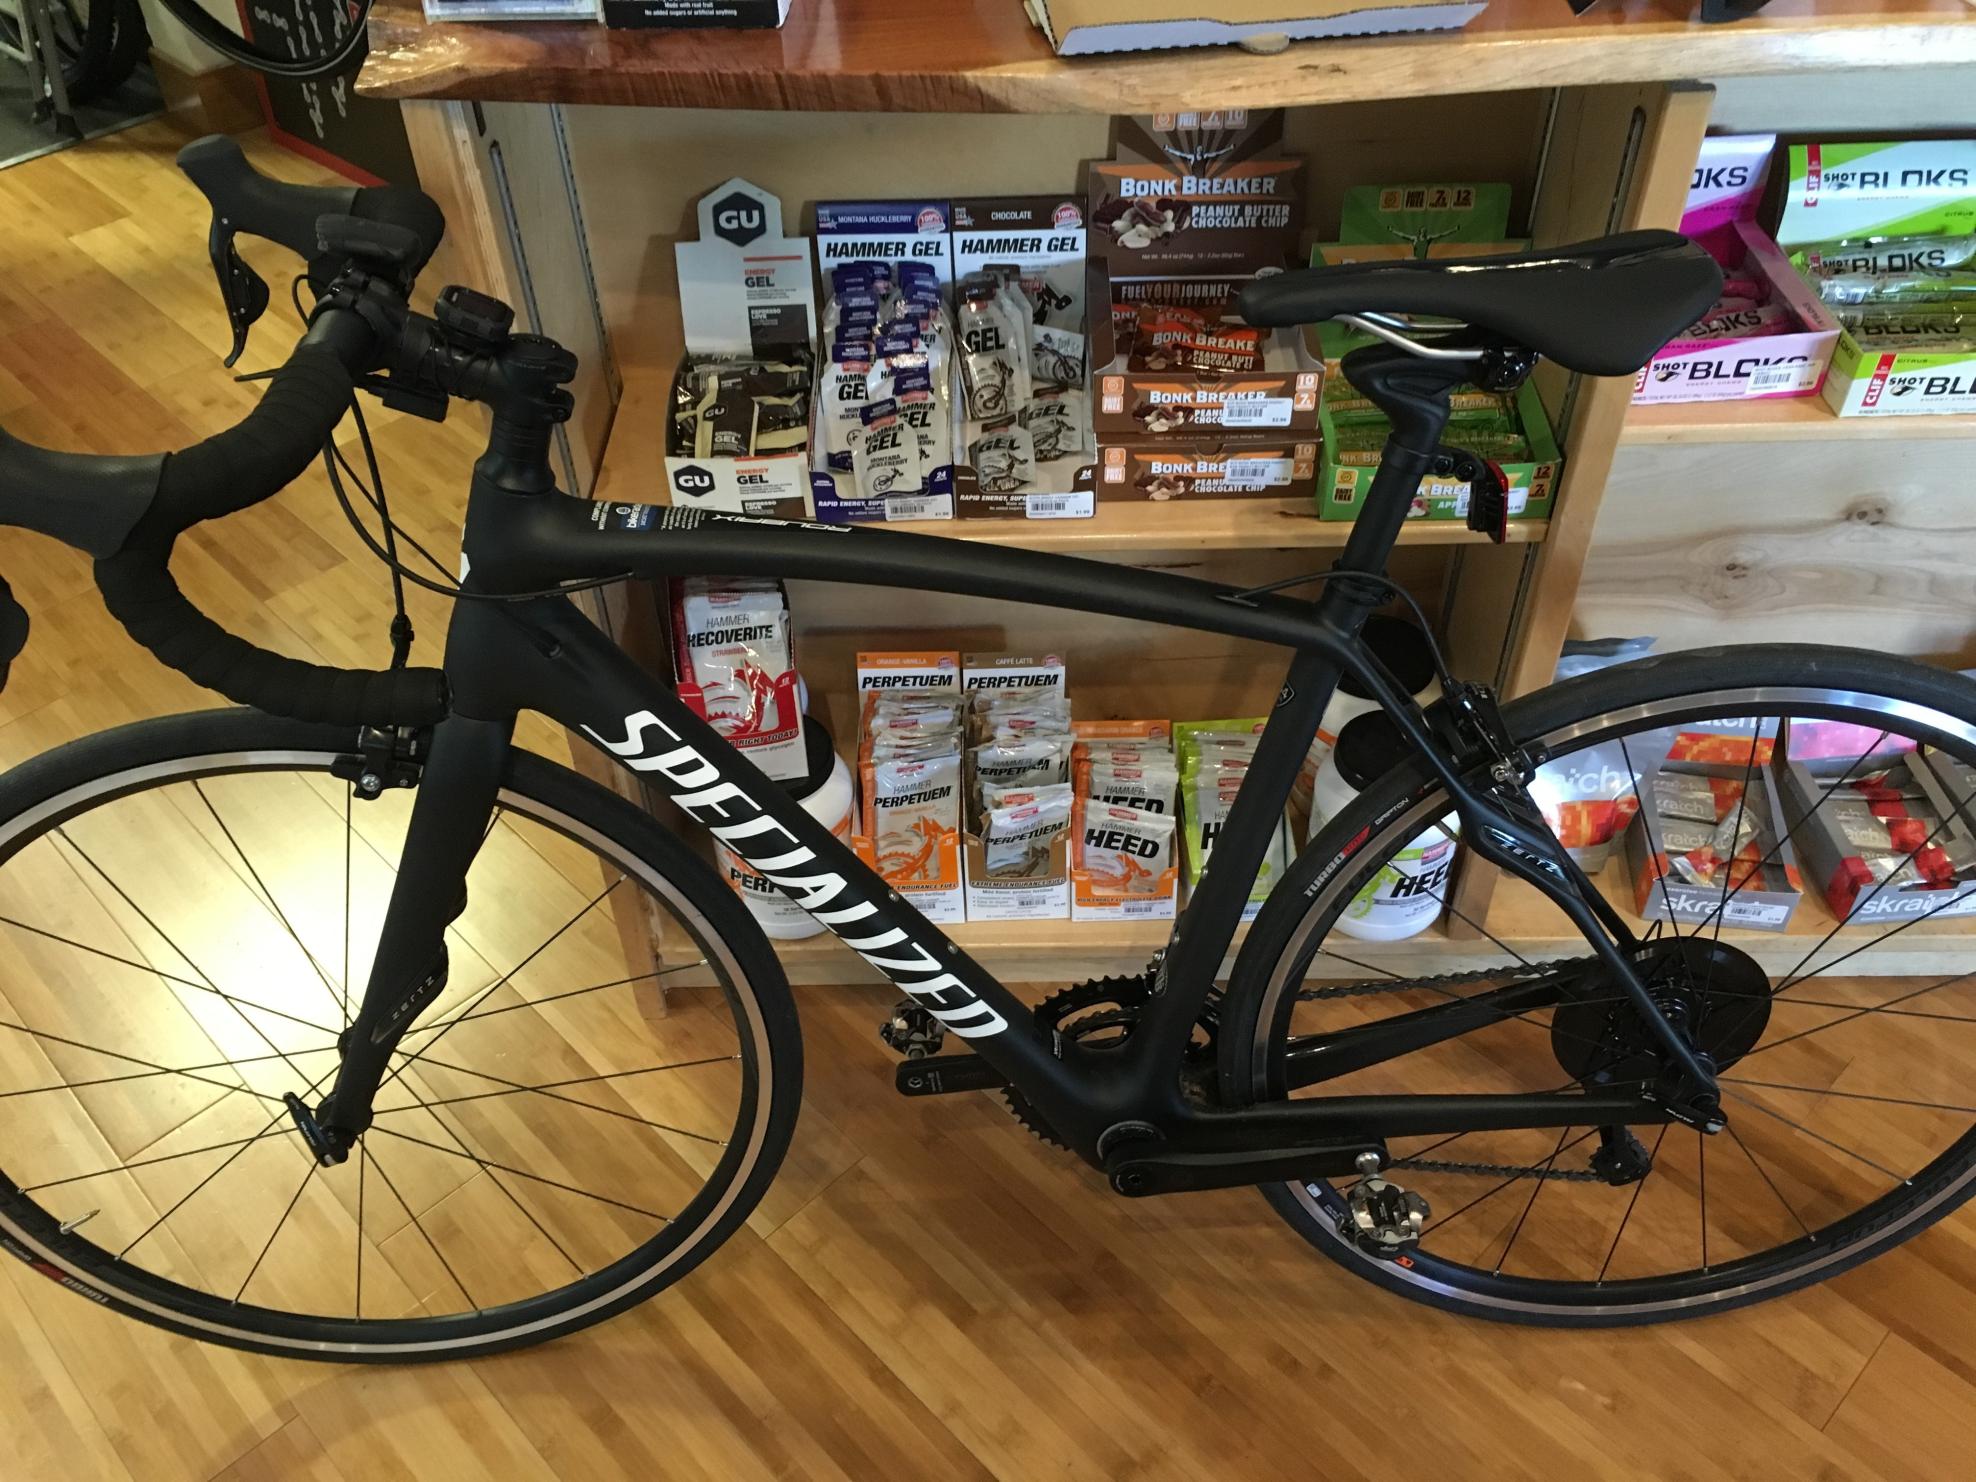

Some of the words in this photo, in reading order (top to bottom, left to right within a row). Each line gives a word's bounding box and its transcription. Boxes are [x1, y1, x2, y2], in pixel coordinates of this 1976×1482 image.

[1823, 172, 1857, 182] SHOT
[1120, 177, 1178, 197] BONK
[1182, 176, 1276, 195] BREAKER
[991, 211, 1032, 221] CHOCOLATE
[1191, 205, 1239, 217] PEANUT
[1244, 205, 1290, 217] BUTTER
[718, 209, 760, 230] GU
[837, 215, 869, 224] MONTANA
[868, 215, 912, 224] HUCKLEBERRY
[1191, 216, 1257, 228] CHOCOLATE
[1261, 216, 1289, 227] CHIP
[825, 242, 907, 258] HAMMER
[911, 241, 944, 257] GEL
[960, 238, 1043, 255] HAMMER
[1046, 236, 1080, 252] GEL
[745, 268, 776, 276] ENERGY
[745, 276, 775, 288] GEL
[965, 326, 1006, 355] GEL
[1152, 331, 1192, 346] BONK
[1195, 333, 1256, 351] BREAKE
[1232, 355, 1254, 364] BUTT
[1652, 362, 1690, 372] SHOT
[835, 374, 867, 384] HAMM
[1888, 376, 1927, 385] SHOT
[1150, 390, 1193, 403] BONK
[1865, 379, 1884, 404] CLIF
[704, 407, 725, 418] GU
[1194, 408, 1225, 418] PEANU
[1194, 416, 1223, 425] CHOCO
[714, 435, 739, 443] GEL
[866, 432, 902, 456] GEL
[736, 467, 769, 475] ENERGY
[1151, 461, 1194, 474] BONK
[736, 475, 769, 485] GEL
[1081, 469, 1093, 479] 24
[678, 475, 711, 488] GU
[1194, 478, 1225, 487] PEANU
[1194, 484, 1242, 493] CHOCOLATE
[1009, 494, 1027, 502] SUPE
[706, 614, 750, 628] HAMMER
[687, 624, 774, 648] RECOVERITE
[1015, 657, 1034, 665] LATTE
[861, 674, 953, 689] PERPETUEM
[967, 674, 1059, 690] PERPETUEM
[893, 779, 932, 794] HAMMER
[1105, 785, 1146, 796] HAMMER
[873, 785, 952, 808] PERPETUEM
[985, 822, 1064, 846] PERPETUEM
[1101, 821, 1142, 835] HAMMER
[1084, 828, 1160, 858] HEED
[579, 709, 1009, 1038] SPECIALIZED
[1303, 851, 1347, 898] TURBO
